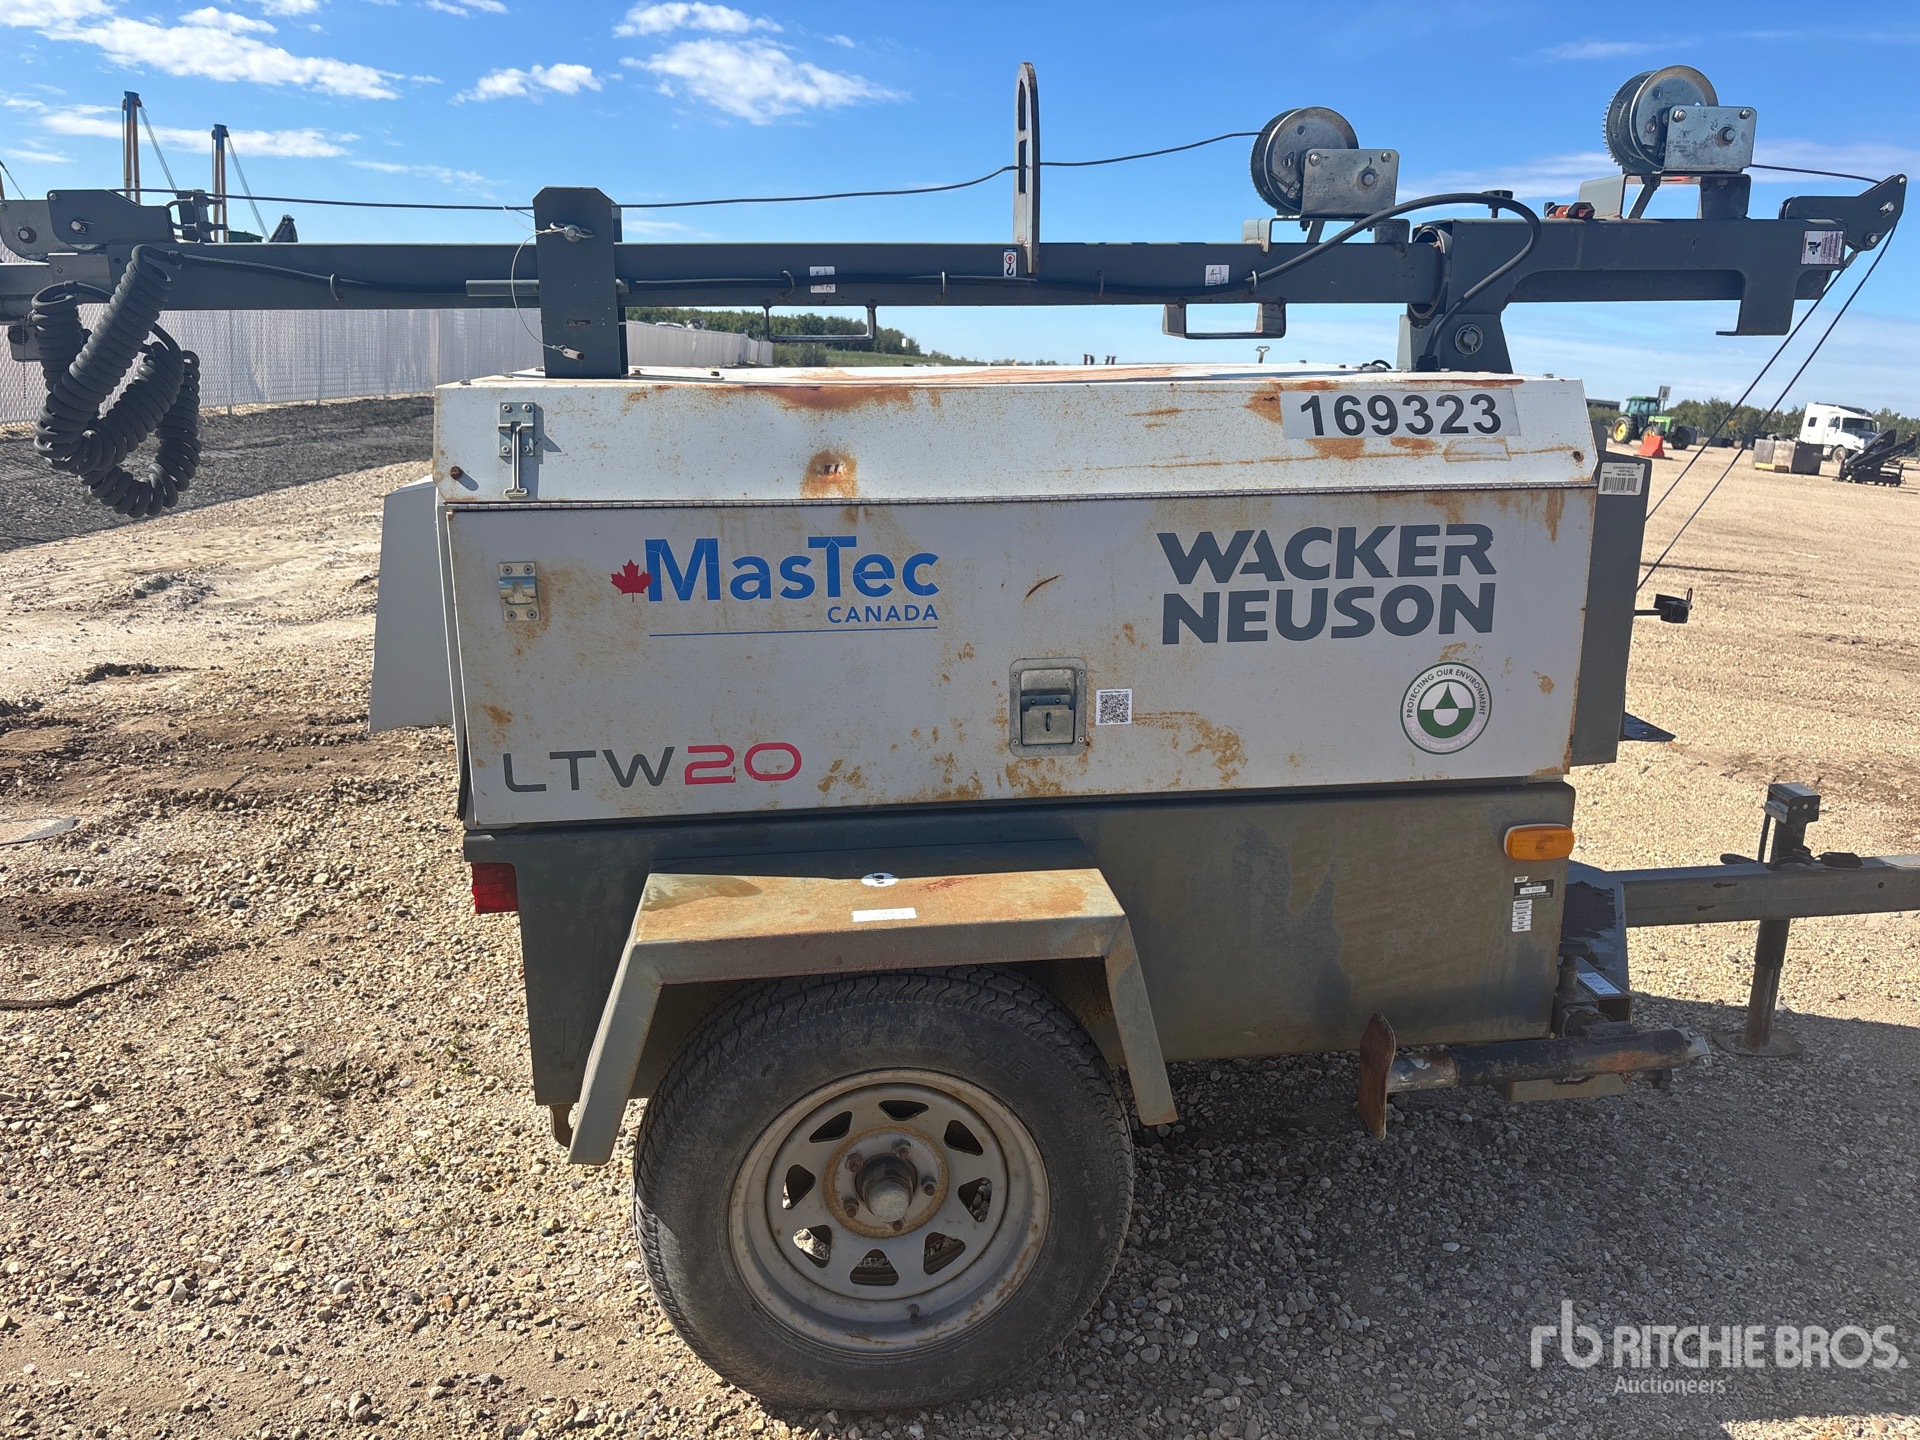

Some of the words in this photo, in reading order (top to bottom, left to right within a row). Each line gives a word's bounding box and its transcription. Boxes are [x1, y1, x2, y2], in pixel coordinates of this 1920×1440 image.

[1300, 393, 1501, 436] 169323
[644, 536, 940, 602] MasTec
[1157, 523, 1498, 584] WACKER
[827, 604, 939, 624] CANADA
[1162, 583, 1496, 645] NEUSON
[1406, 673, 1435, 718] PROTECTING
[1436, 668, 1454, 677] OUR
[1455, 669, 1487, 715] ENVIRONMENT
[1460, 721, 1482, 742] System
[840, 1024, 1034, 1082] CARLISLE
